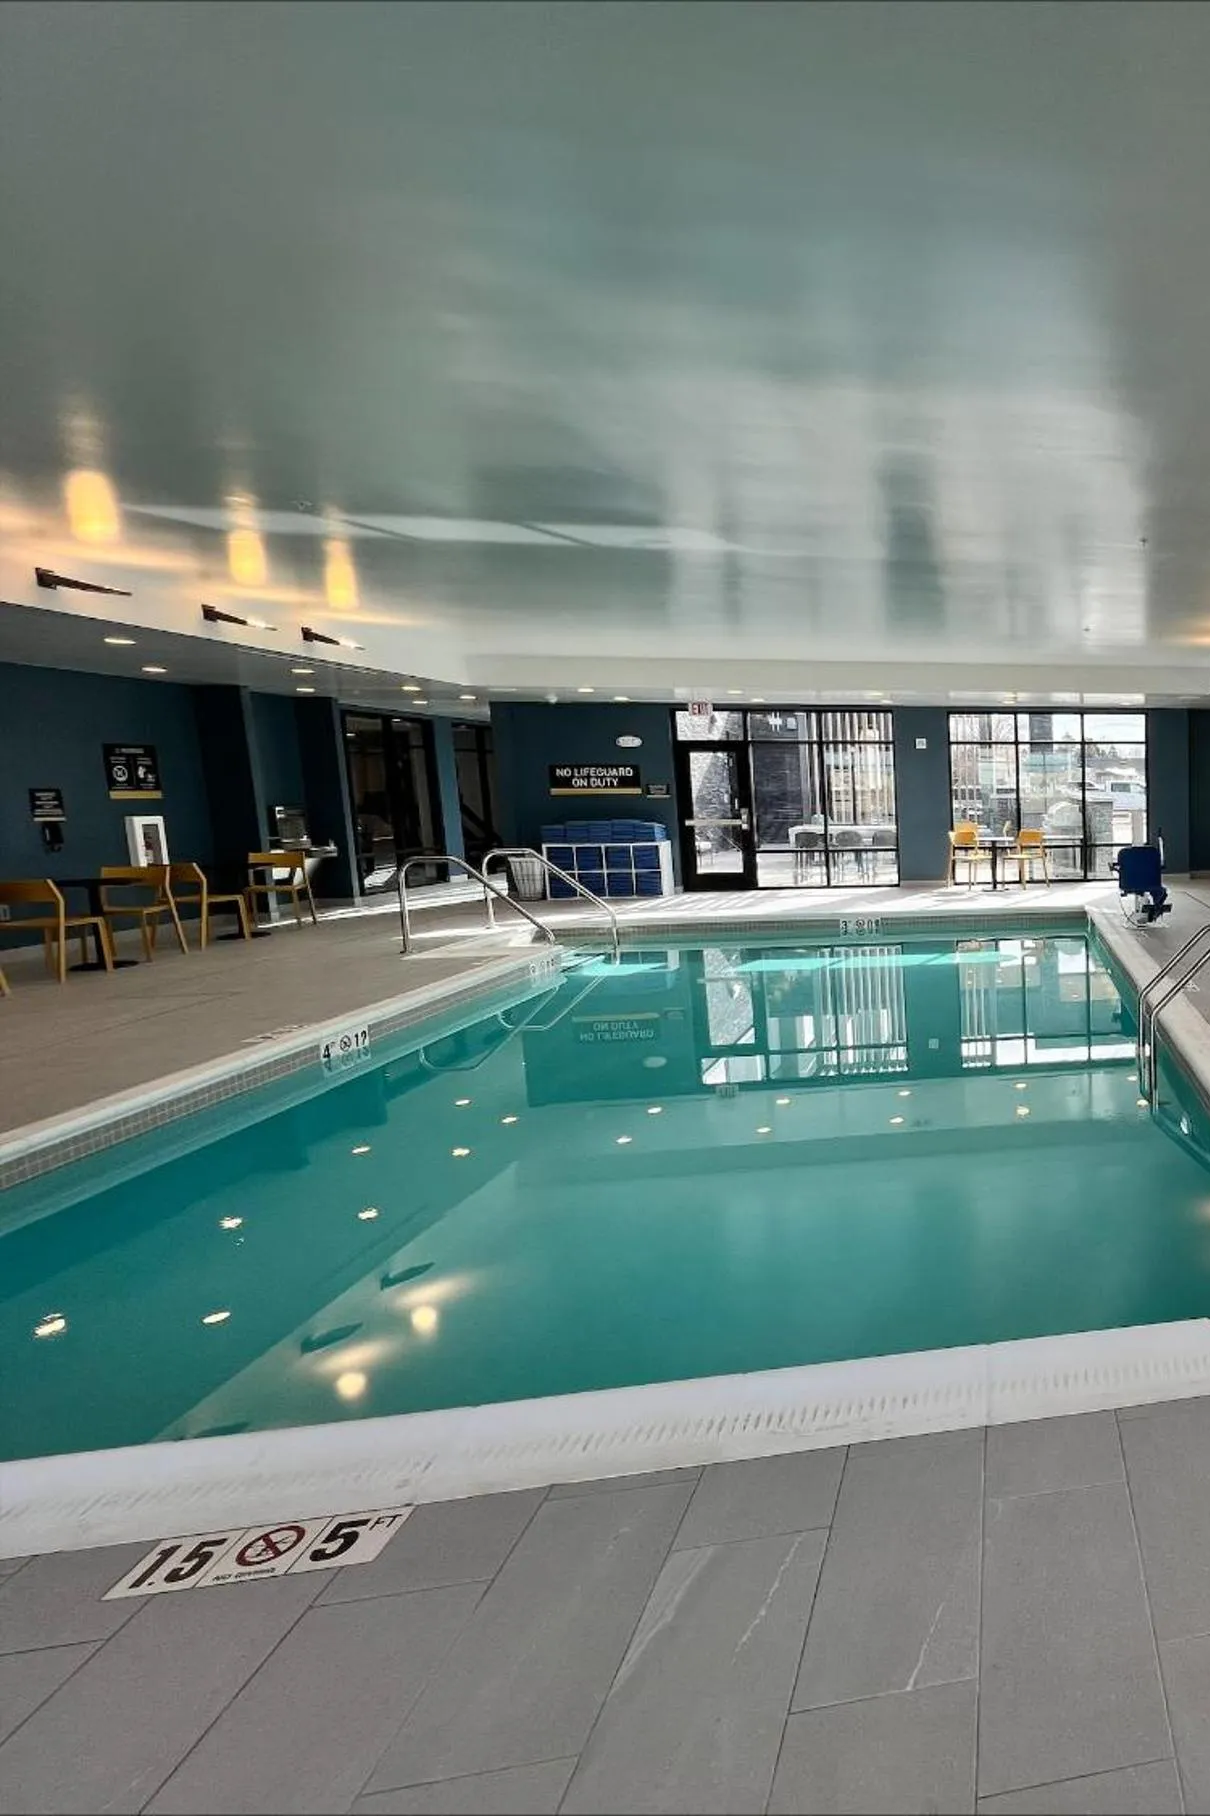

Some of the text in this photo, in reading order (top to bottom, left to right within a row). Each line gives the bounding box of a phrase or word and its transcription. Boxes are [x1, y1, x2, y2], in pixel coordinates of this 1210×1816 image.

[556, 766, 634, 777] NO LIFEGUARD
[572, 777, 619, 787] ON DUTY
[129, 1513, 403, 1589] 1.5 5 FT
